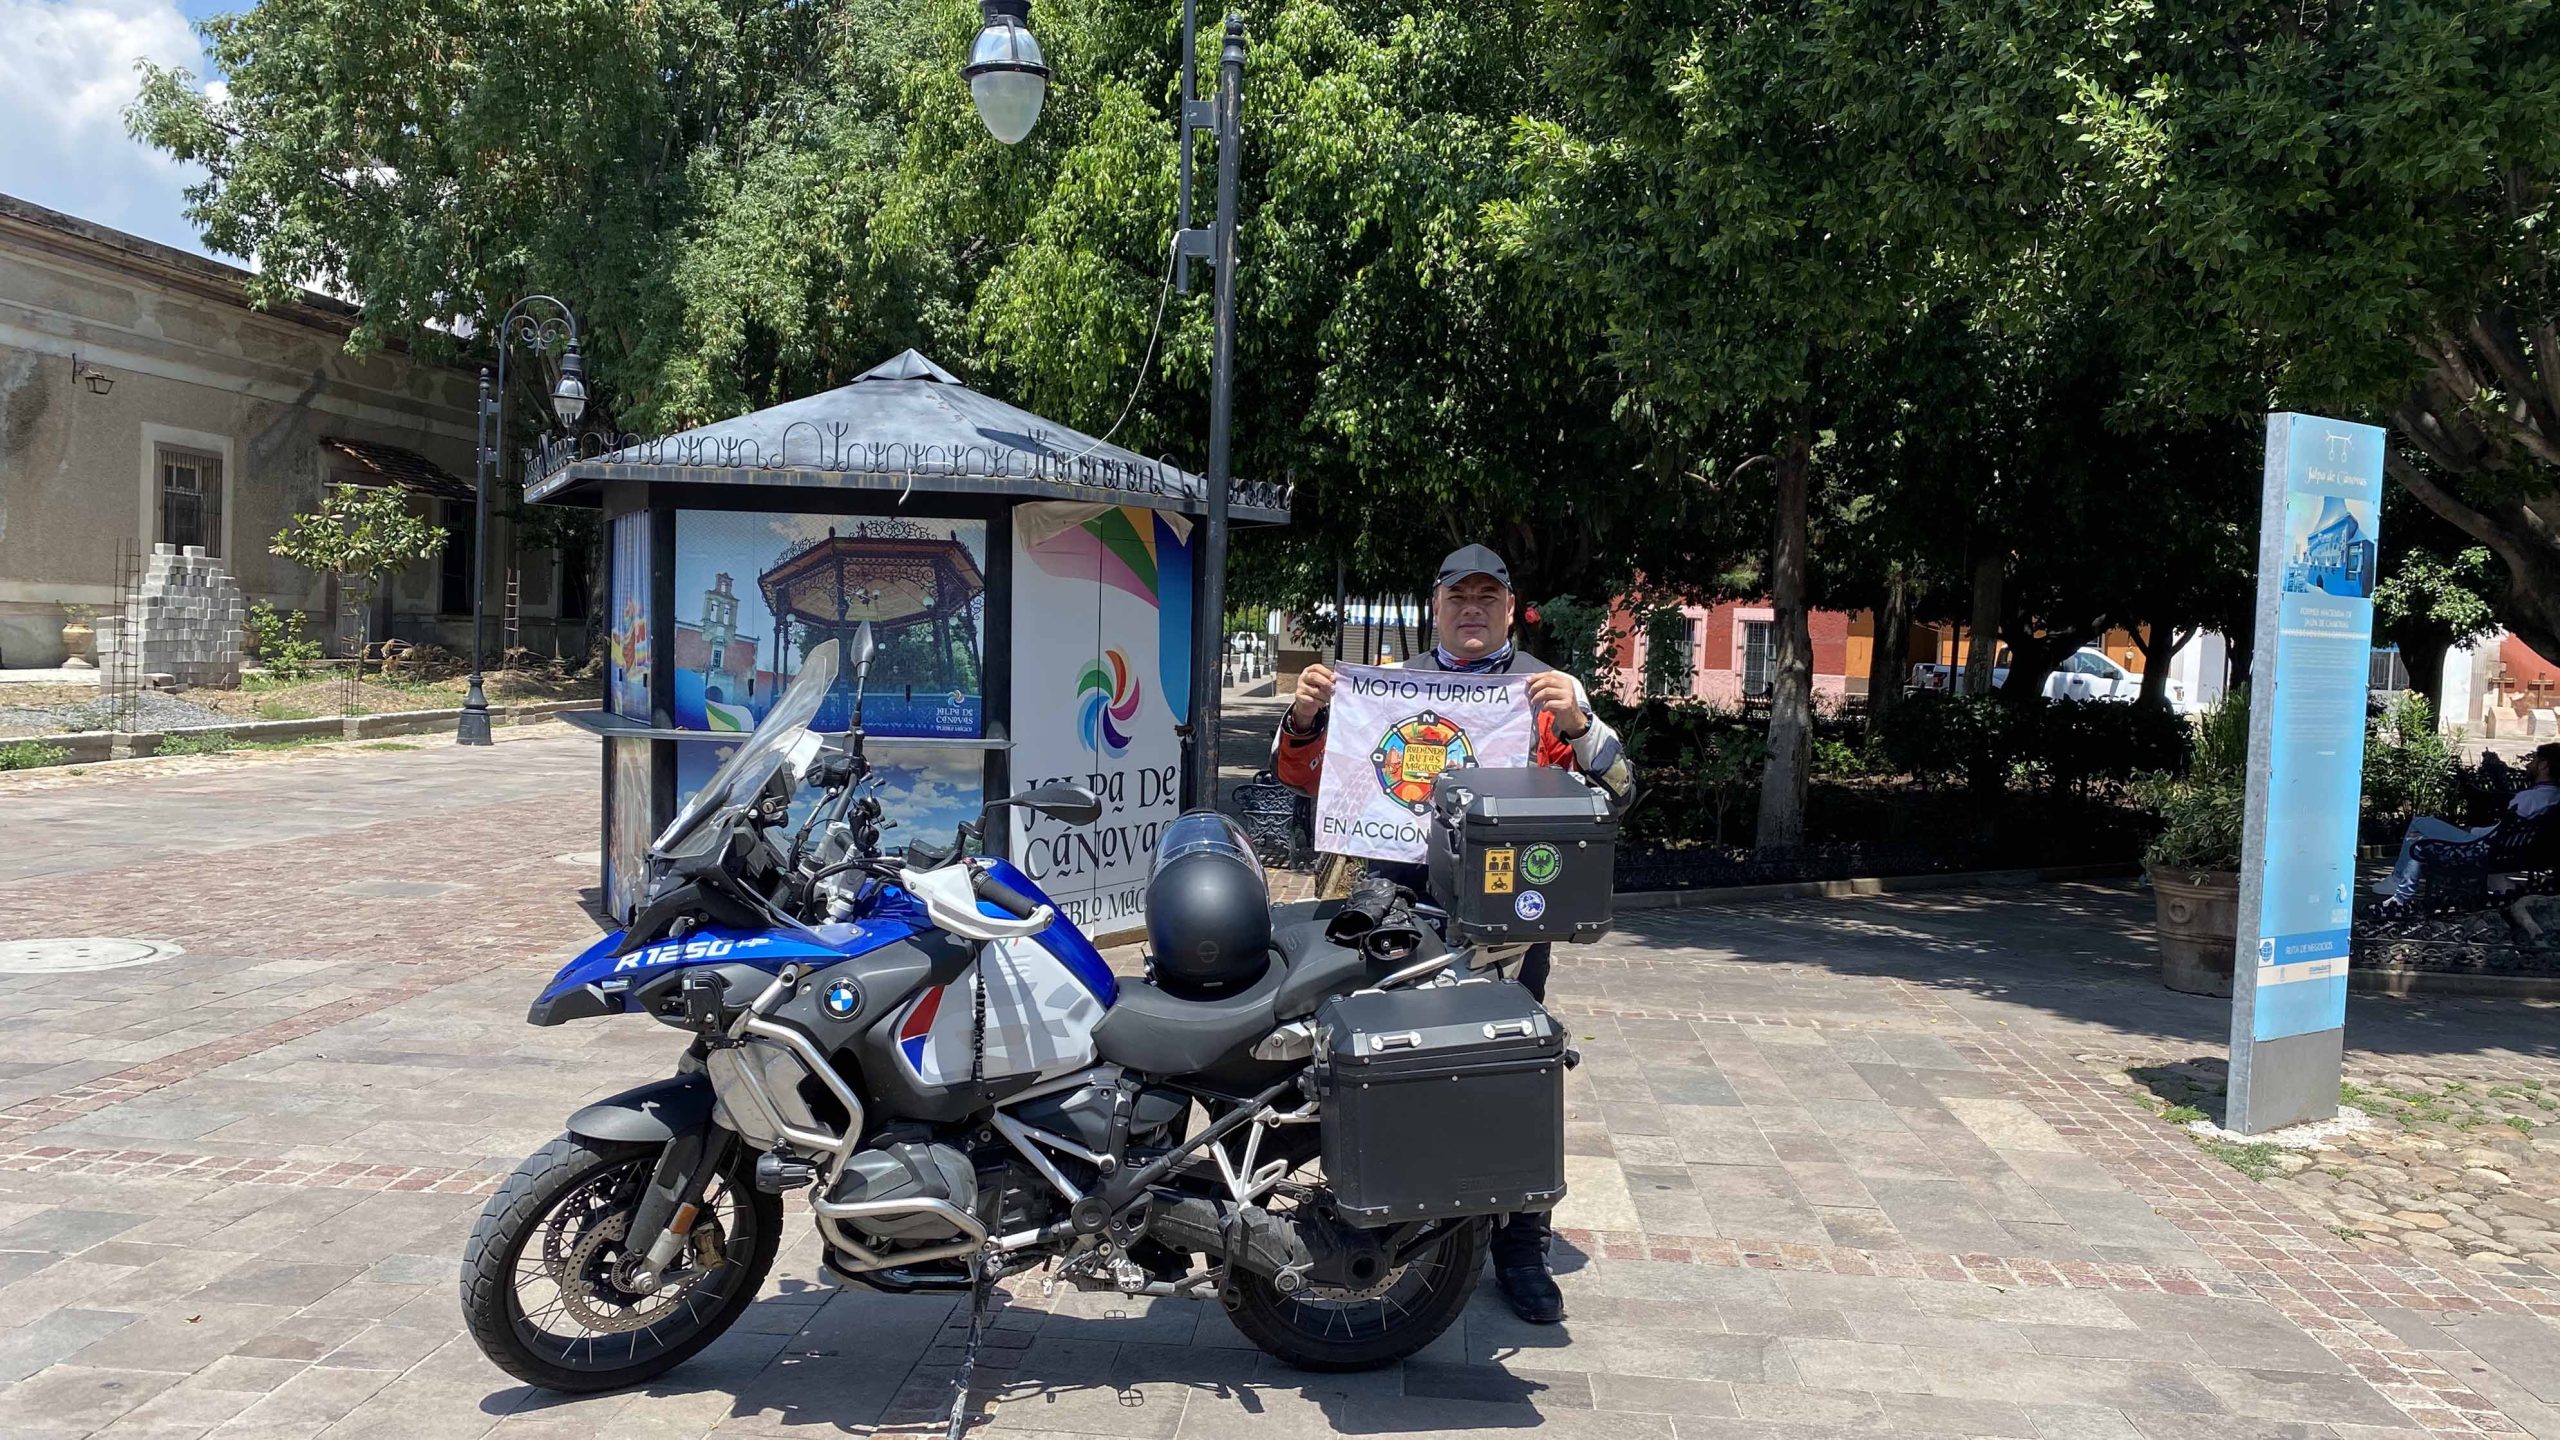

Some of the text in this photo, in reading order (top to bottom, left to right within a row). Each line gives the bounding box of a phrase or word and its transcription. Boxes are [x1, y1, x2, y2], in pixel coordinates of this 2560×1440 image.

[1352, 676, 1510, 704] MOTO TURISTA
[1422, 713, 1435, 723] N
[1372, 753, 1384, 762] O
[1414, 804, 1425, 812] S
[1323, 816, 1430, 844] EN ACCIÓN
[614, 953, 645, 972] R
[647, 940, 733, 966] 1250
[826, 982, 857, 996] BMW
